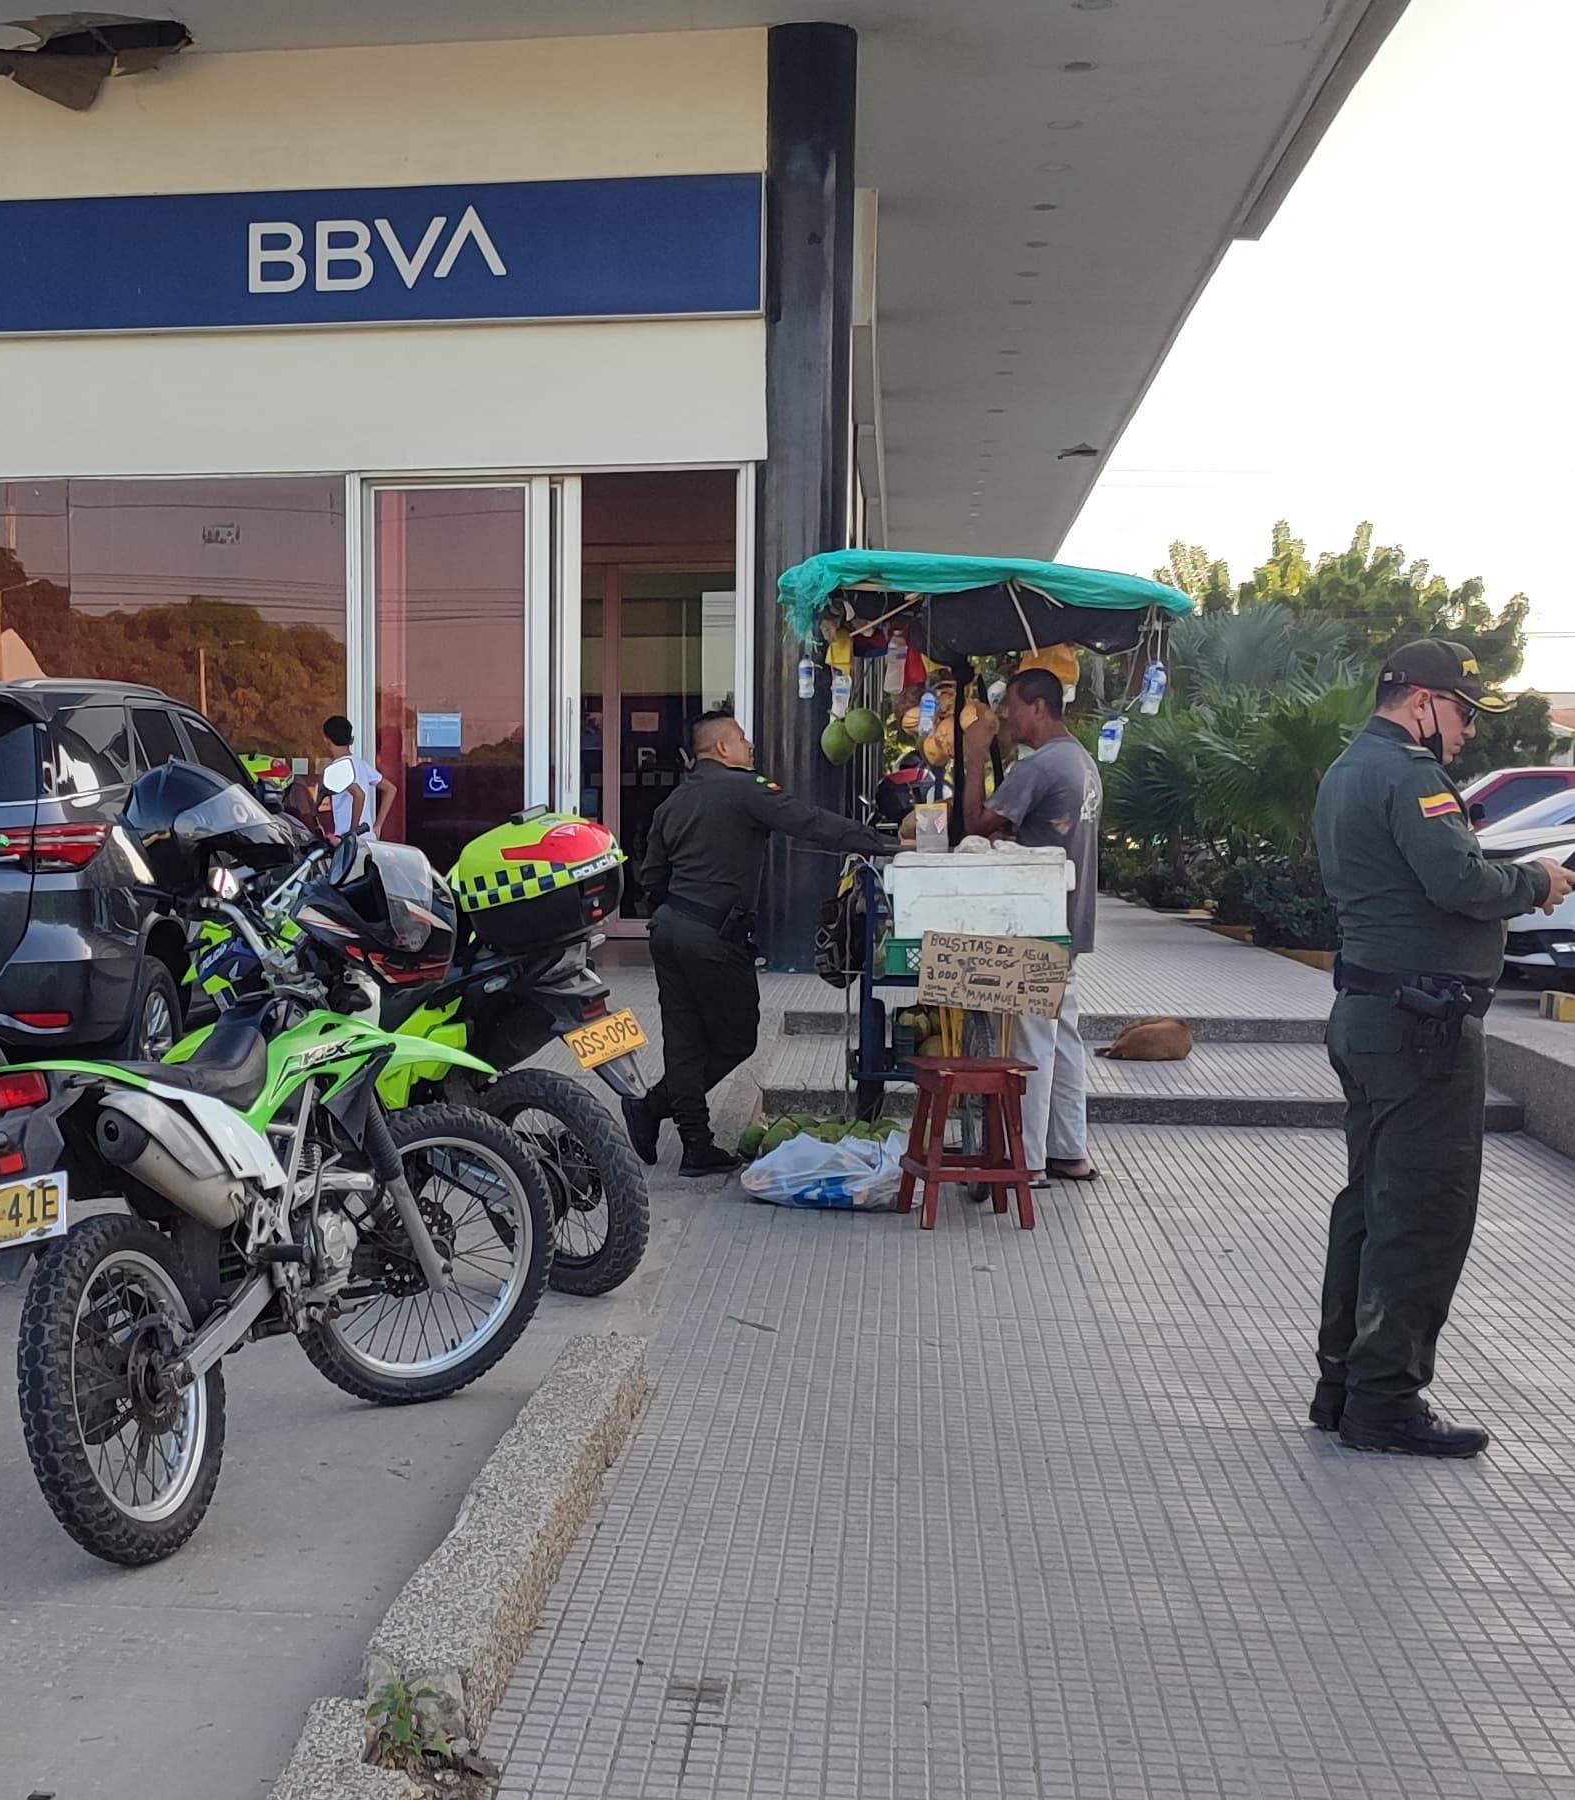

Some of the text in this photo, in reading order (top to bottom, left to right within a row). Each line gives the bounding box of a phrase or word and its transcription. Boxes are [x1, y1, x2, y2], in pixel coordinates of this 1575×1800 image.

[248, 205, 508, 294] BBVA
[931, 934, 994, 955] BOLSITAS
[996, 944, 1016, 957] DE
[937, 953, 953, 964] DE
